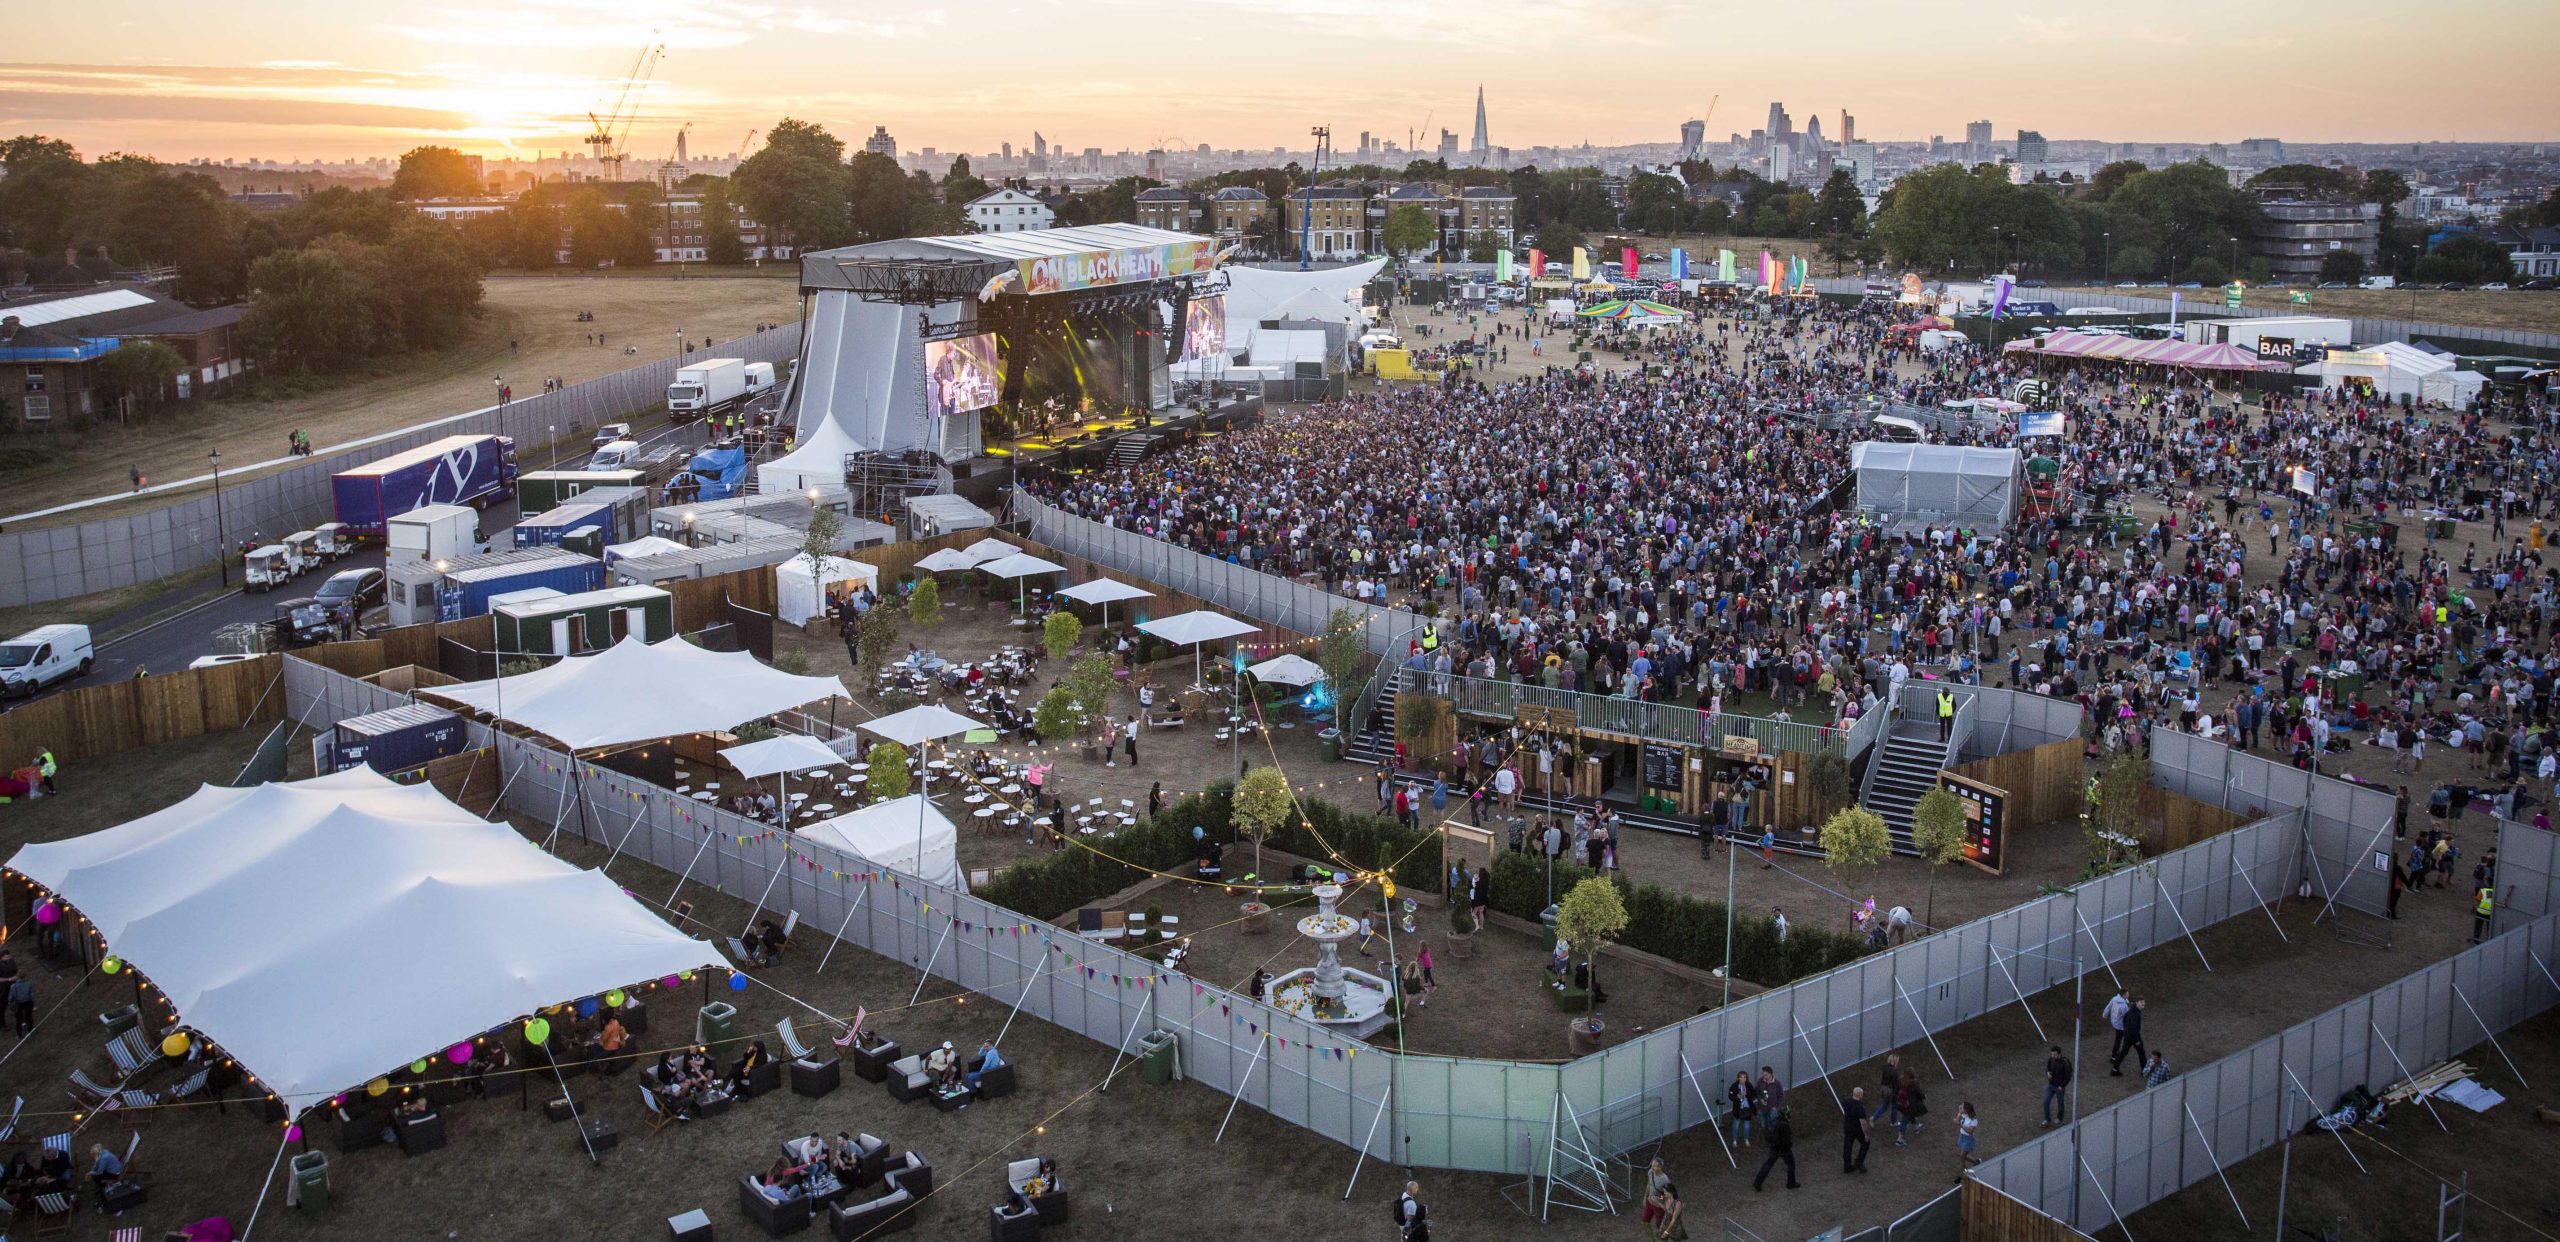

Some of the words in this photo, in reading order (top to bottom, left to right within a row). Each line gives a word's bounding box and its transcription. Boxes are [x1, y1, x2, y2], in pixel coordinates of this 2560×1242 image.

[1031, 259, 1063, 286] ON
[1066, 250, 1164, 283] BLACKHEATH
[2260, 342, 2292, 356] BAR
[1726, 741, 1756, 753] MEANTIME
